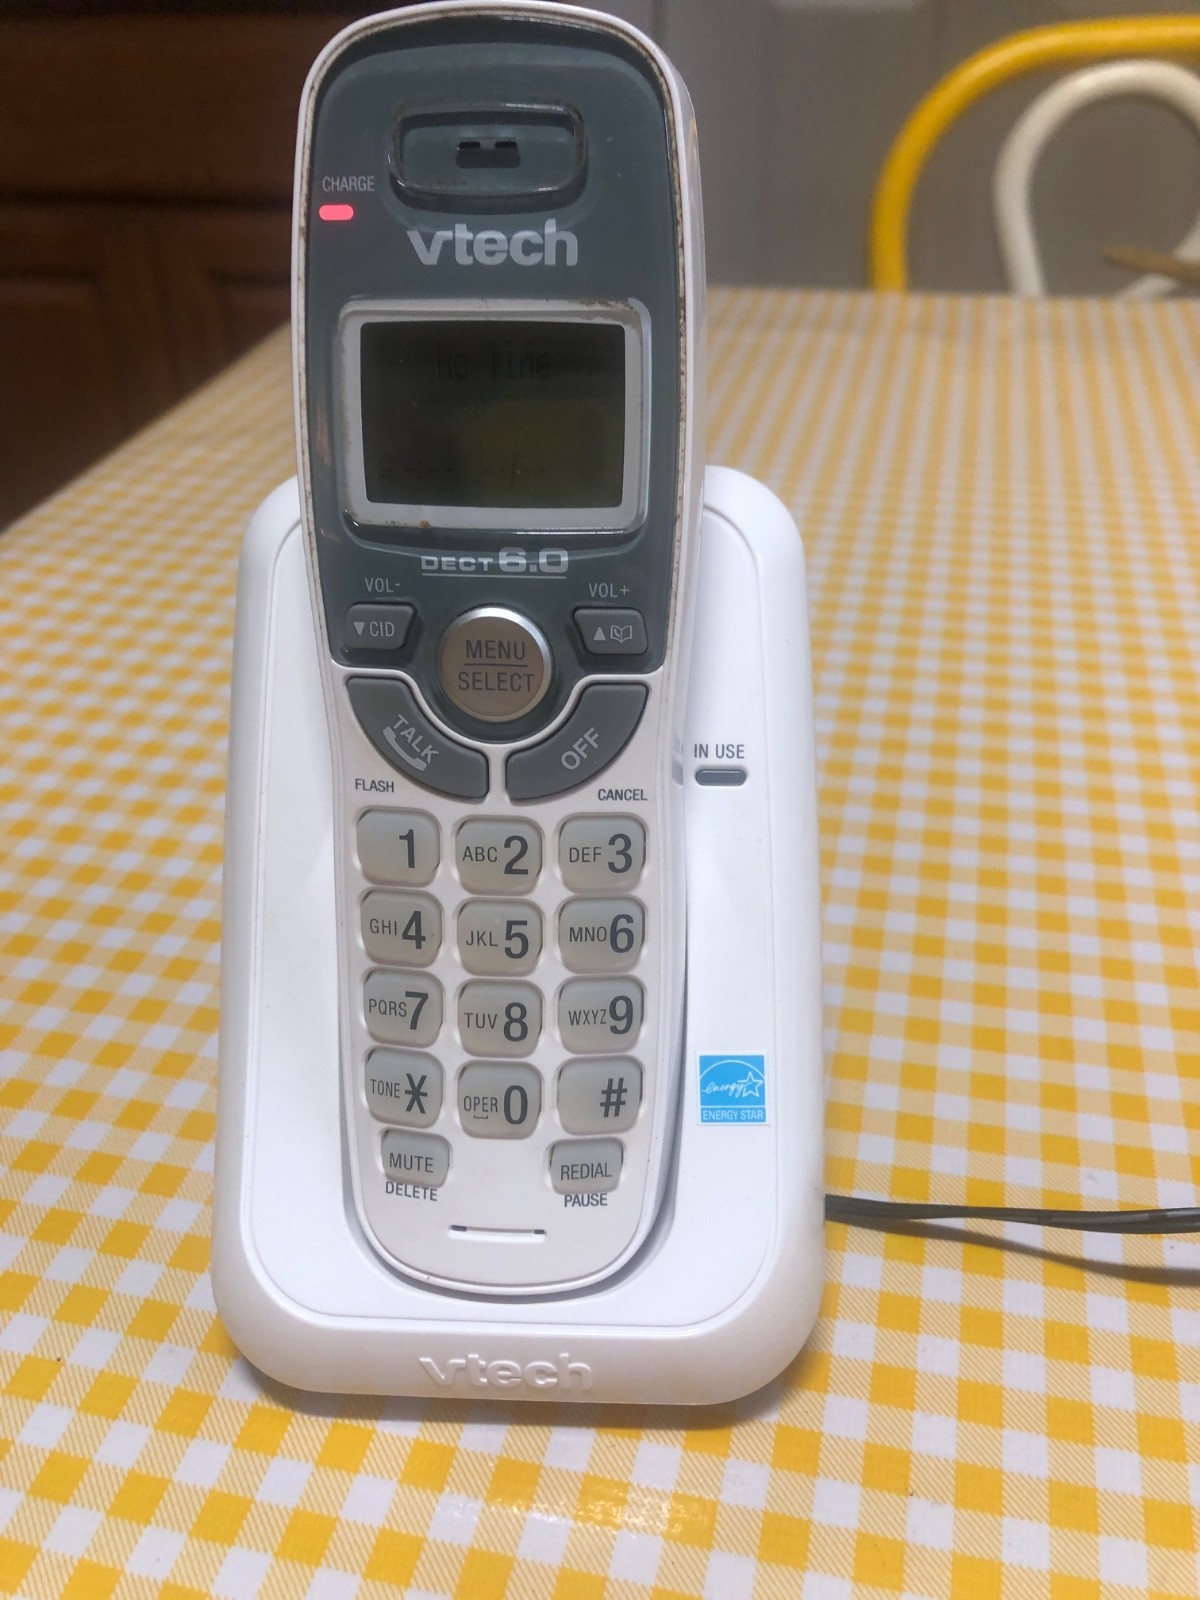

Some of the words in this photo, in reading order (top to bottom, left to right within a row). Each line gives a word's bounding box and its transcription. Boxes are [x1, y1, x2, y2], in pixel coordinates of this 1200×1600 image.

[322, 175, 375, 192] CHARGE
[407, 218, 578, 266] vtech
[421, 555, 494, 573] DECT
[498, 547, 569, 574] 6.0
[364, 577, 401, 593] VOL-
[588, 582, 630, 598] VOL+
[369, 621, 395, 638] CID
[465, 639, 526, 661] MENU
[457, 671, 535, 693] SELECT
[394, 714, 440, 765] TALK
[560, 727, 603, 771] OFF
[694, 743, 708, 758] IN
[715, 744, 745, 759] USE
[354, 778, 395, 794] FLASH
[597, 788, 648, 802] CANCEL
[399, 829, 415, 869] 1
[462, 846, 498, 862] ABC
[503, 835, 529, 875] 2
[568, 846, 602, 863] DEF
[607, 833, 633, 873] 3
[369, 918, 398, 936] GHI
[401, 910, 426, 950] 4
[465, 930, 498, 947] JKL
[504, 919, 529, 959] 5
[569, 926, 607, 942] MNO
[609, 913, 634, 953] 6
[368, 998, 407, 1017] PQRS
[404, 990, 429, 1030] 7
[463, 1012, 498, 1029] TUV
[503, 1001, 528, 1042] 8
[568, 1009, 607, 1026] WXYZ
[609, 995, 634, 1035] 9
[370, 1078, 401, 1099] TONE
[600, 1077, 627, 1118] #
[463, 1095, 498, 1113] OPER
[503, 1085, 528, 1125] 0
[702, 1109, 738, 1121] ENERGY
[740, 1109, 764, 1121] STAR
[389, 1152, 434, 1174] MUTE
[560, 1162, 613, 1181] REDIAL
[385, 1181, 438, 1201] DELETE
[564, 1193, 608, 1207] PAUSE
[418, 1352, 592, 1390] vtech
